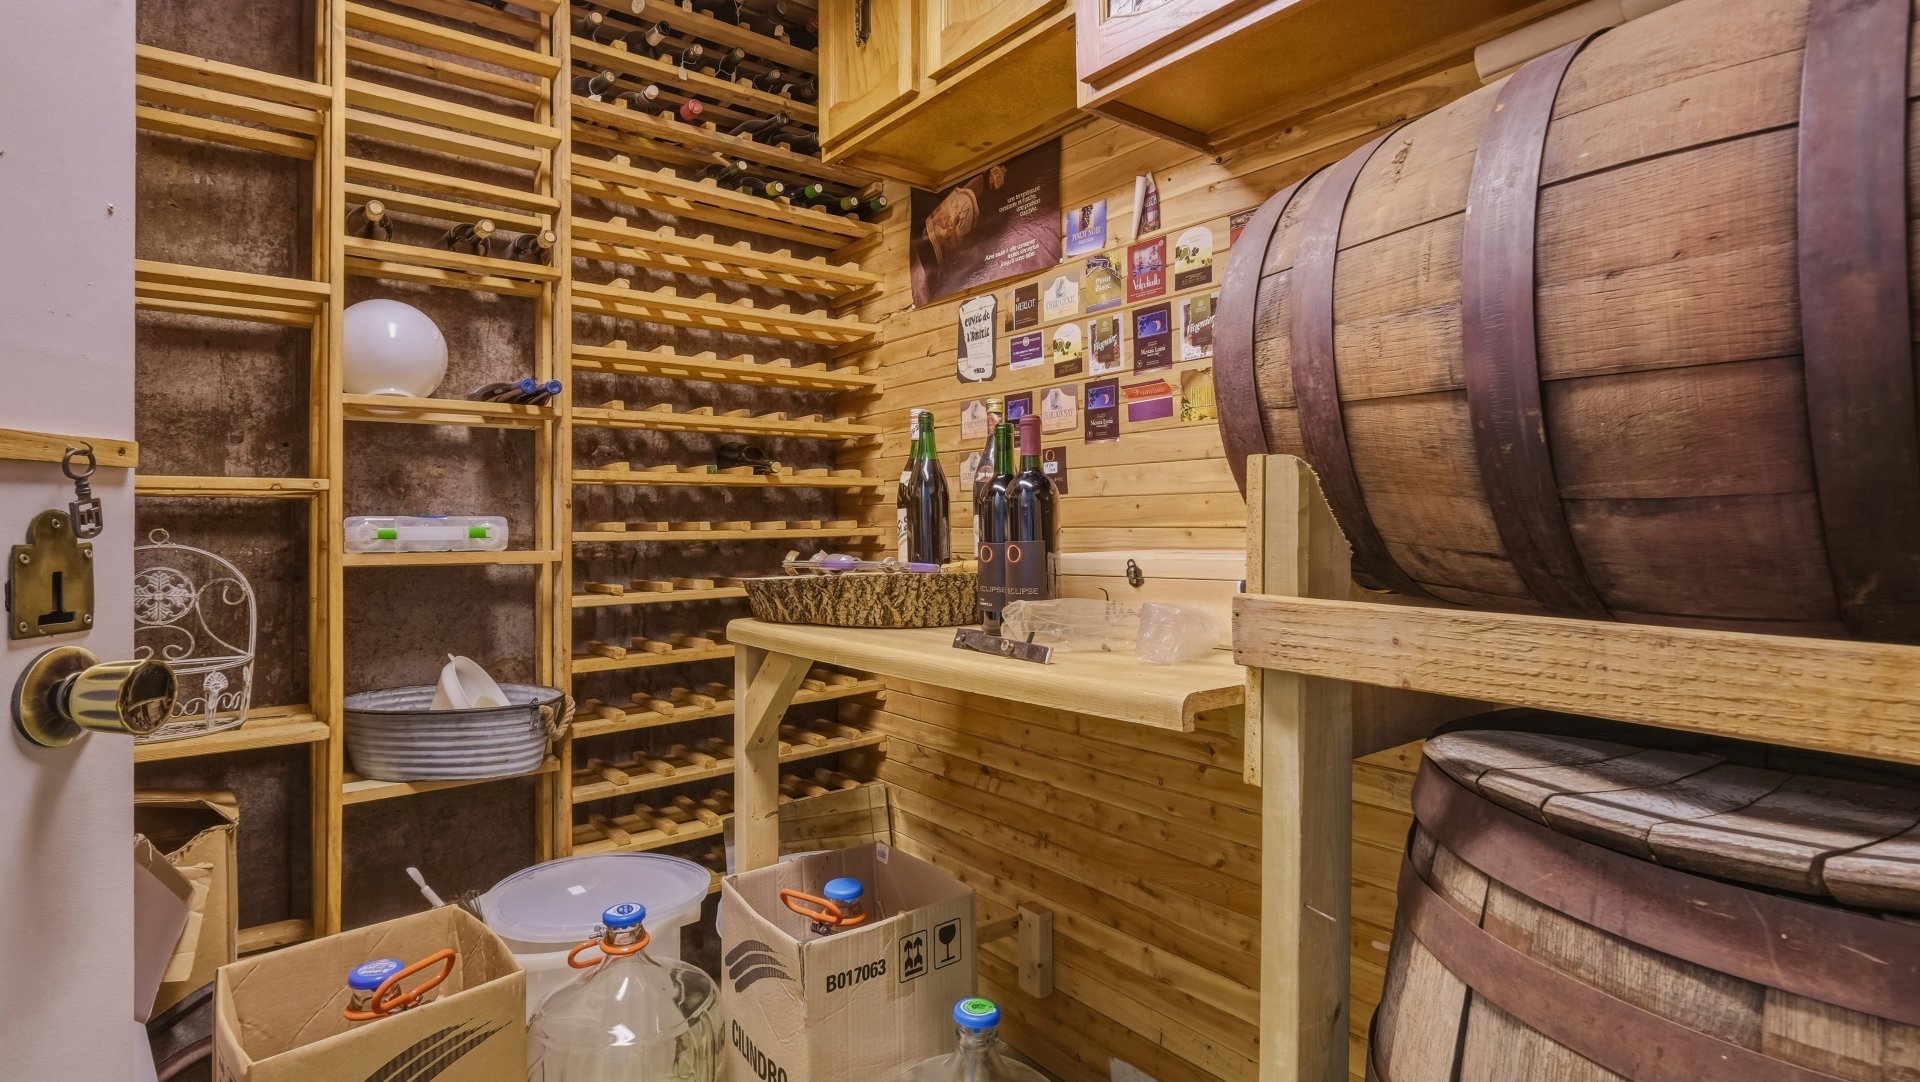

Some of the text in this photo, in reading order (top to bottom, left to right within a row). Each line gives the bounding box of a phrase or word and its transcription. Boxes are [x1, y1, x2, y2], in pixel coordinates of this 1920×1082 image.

[1072, 230, 1087, 241] PINOT
[1087, 225, 1101, 237] NOIR
[1095, 275, 1111, 285] Pinot
[1095, 284, 1112, 292] Blanc
[1016, 299, 1036, 311] MERLOT
[1007, 587, 1039, 595] ECLIPSE
[826, 958, 886, 993] B017063
